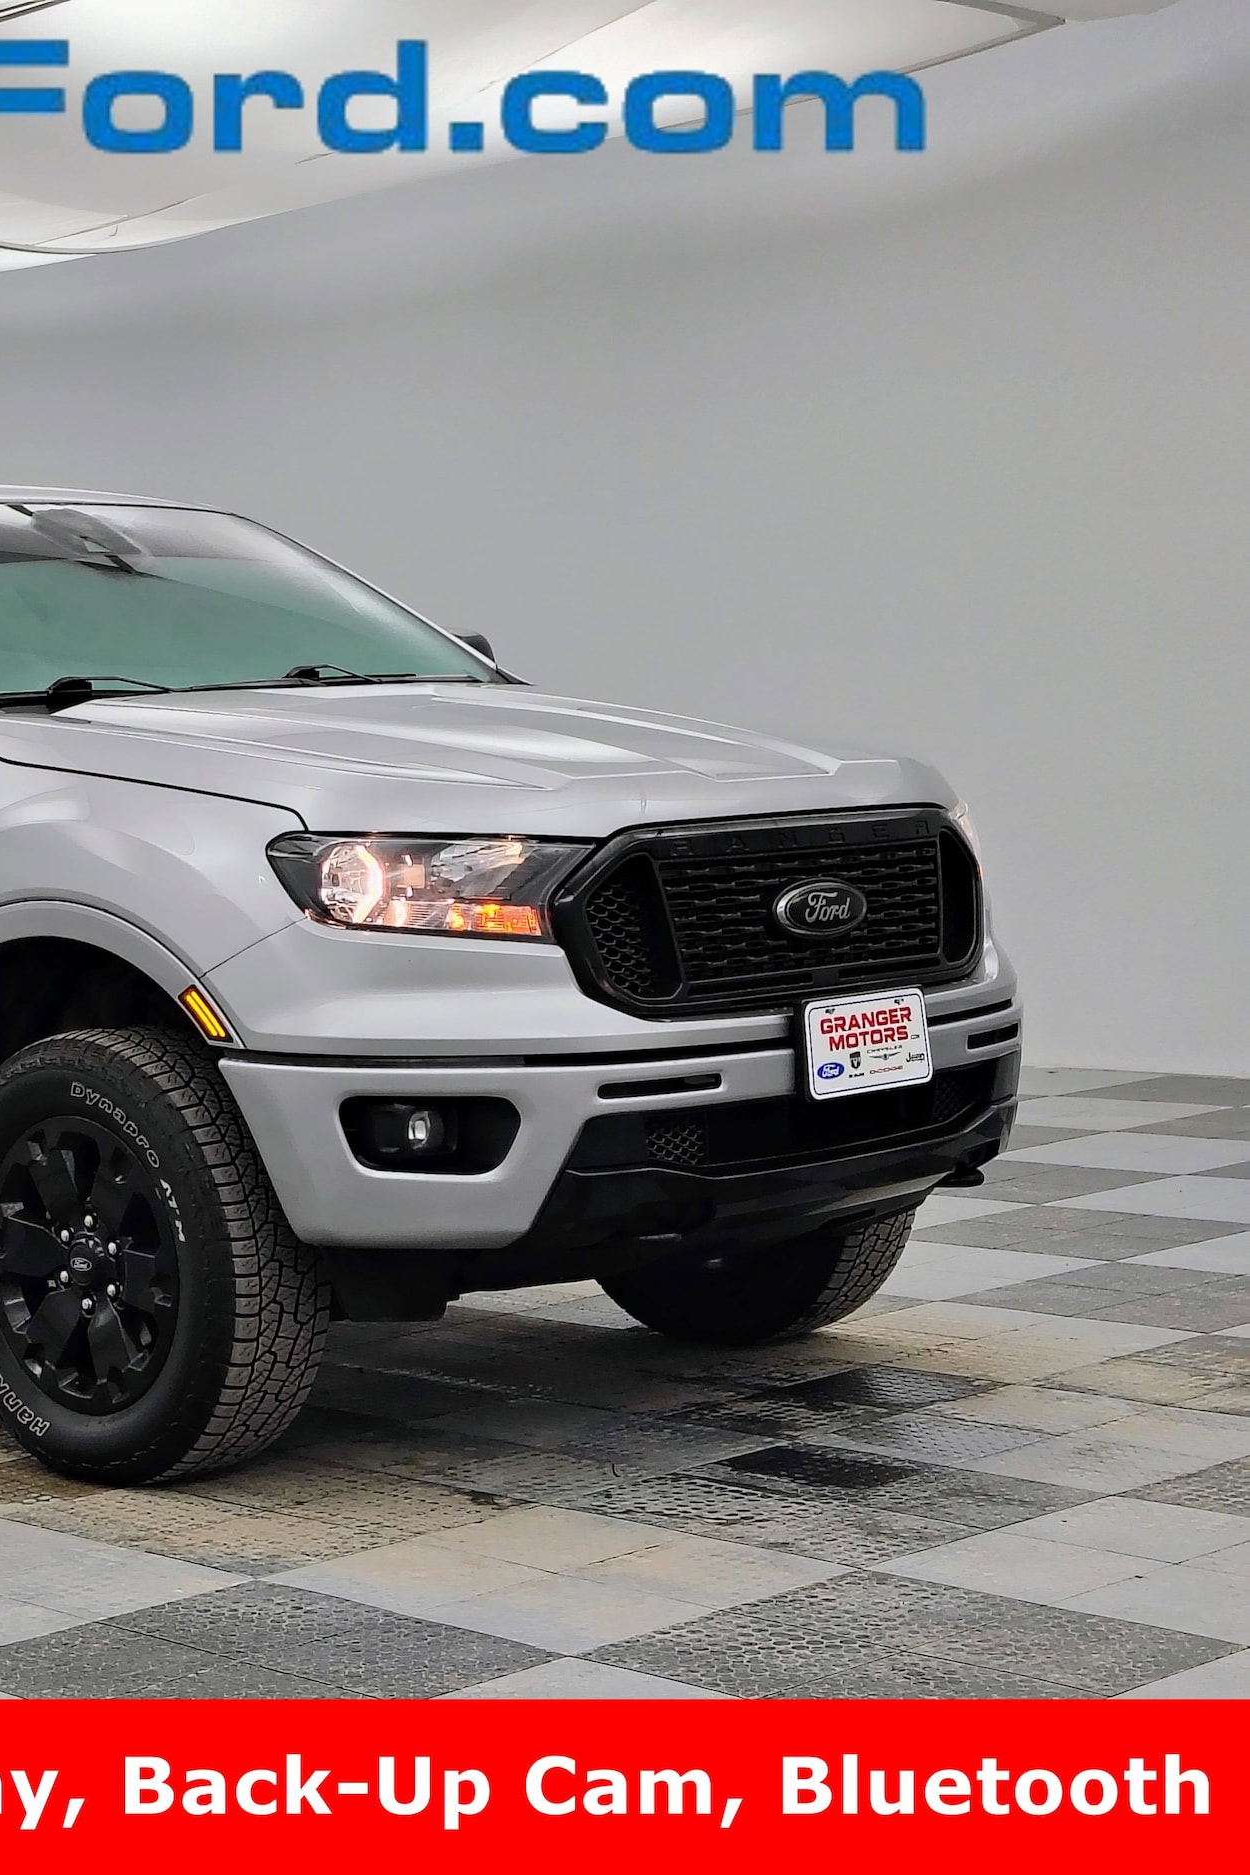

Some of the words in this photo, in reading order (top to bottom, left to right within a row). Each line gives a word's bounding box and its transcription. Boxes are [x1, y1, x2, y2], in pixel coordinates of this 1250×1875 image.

[804, 891, 851, 923] Ford
[820, 1006, 912, 1035] GRANGER
[829, 1025, 909, 1052] MOTORS
